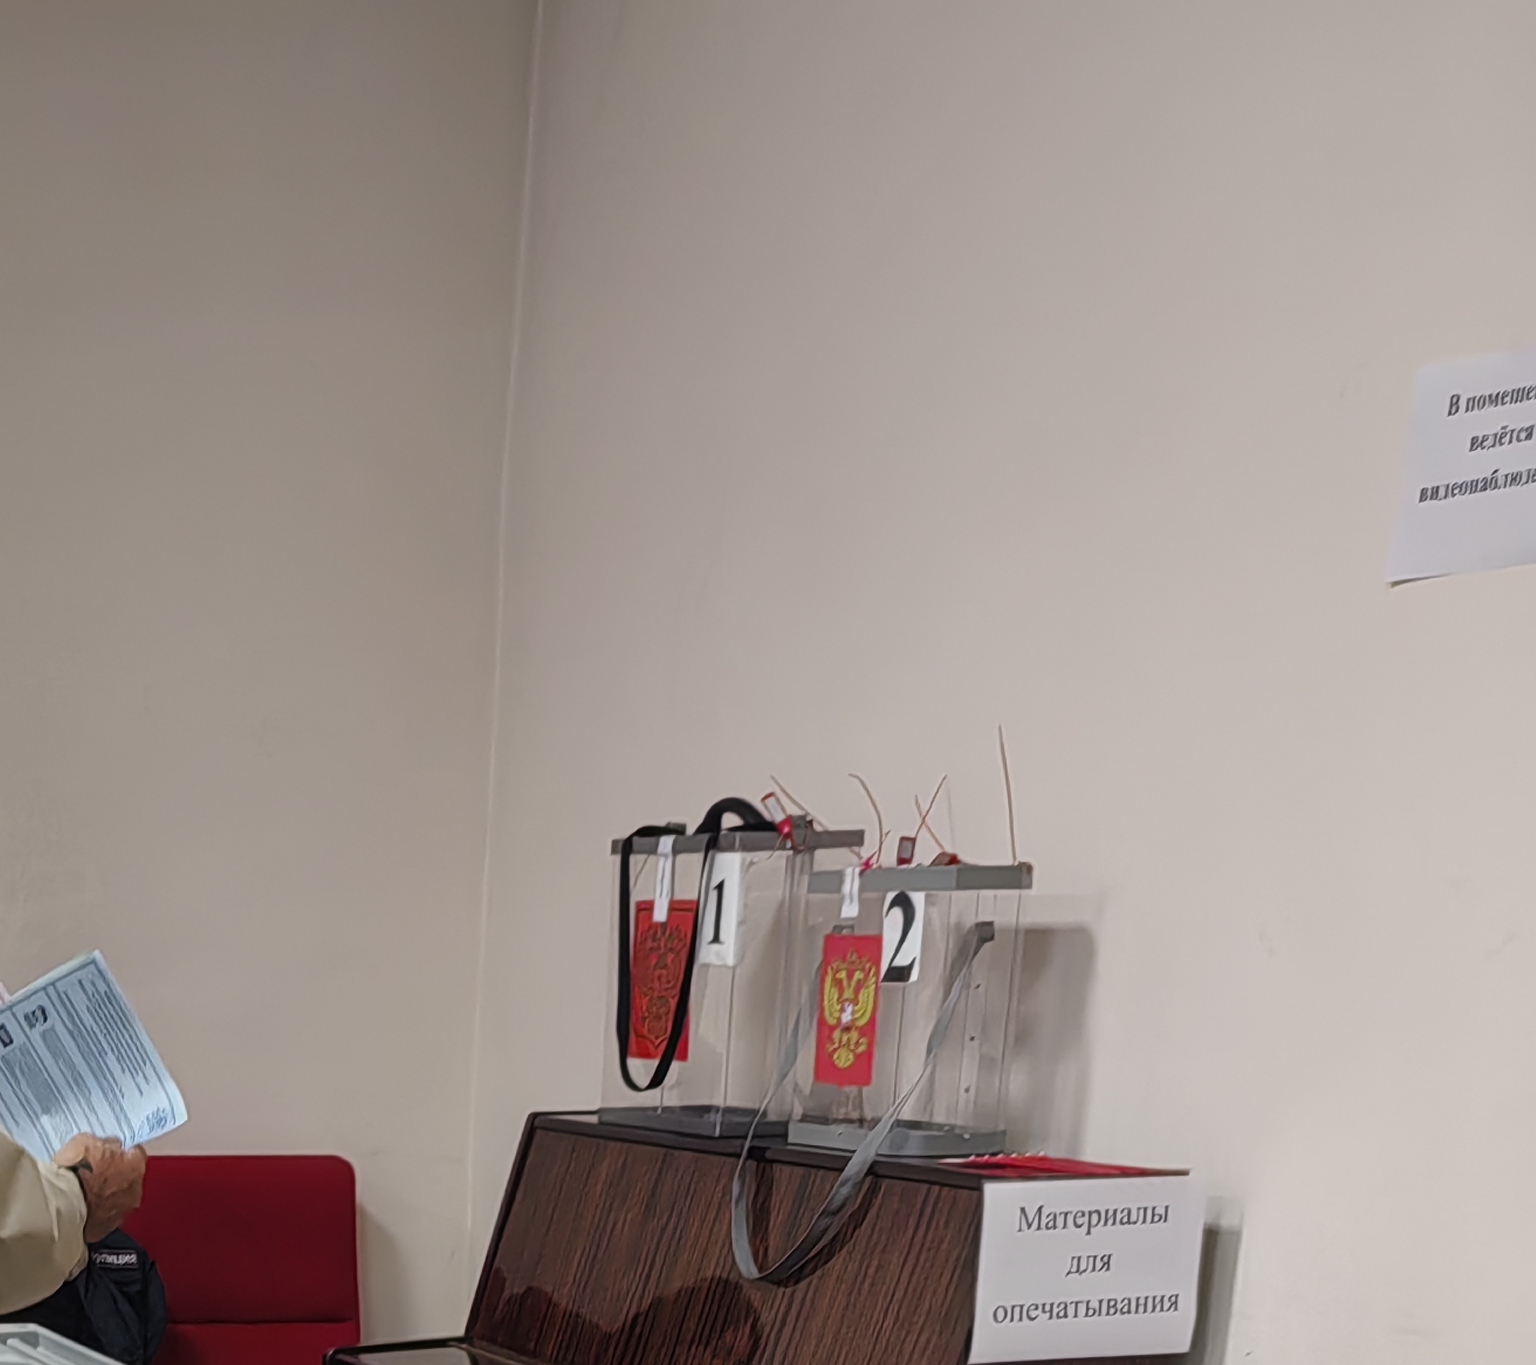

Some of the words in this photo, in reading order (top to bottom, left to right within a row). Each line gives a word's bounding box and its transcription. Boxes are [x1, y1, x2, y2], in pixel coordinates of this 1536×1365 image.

[1447, 393, 1461, 417] В
[1464, 384, 1536, 414] помеще
[1469, 424, 1536, 453] ведётся
[707, 877, 726, 945] 1
[880, 890, 917, 983] 2
[1017, 1204, 1170, 1236] Материалы
[1065, 1253, 1113, 1277] для
[992, 1293, 1180, 1324] опечатывания
